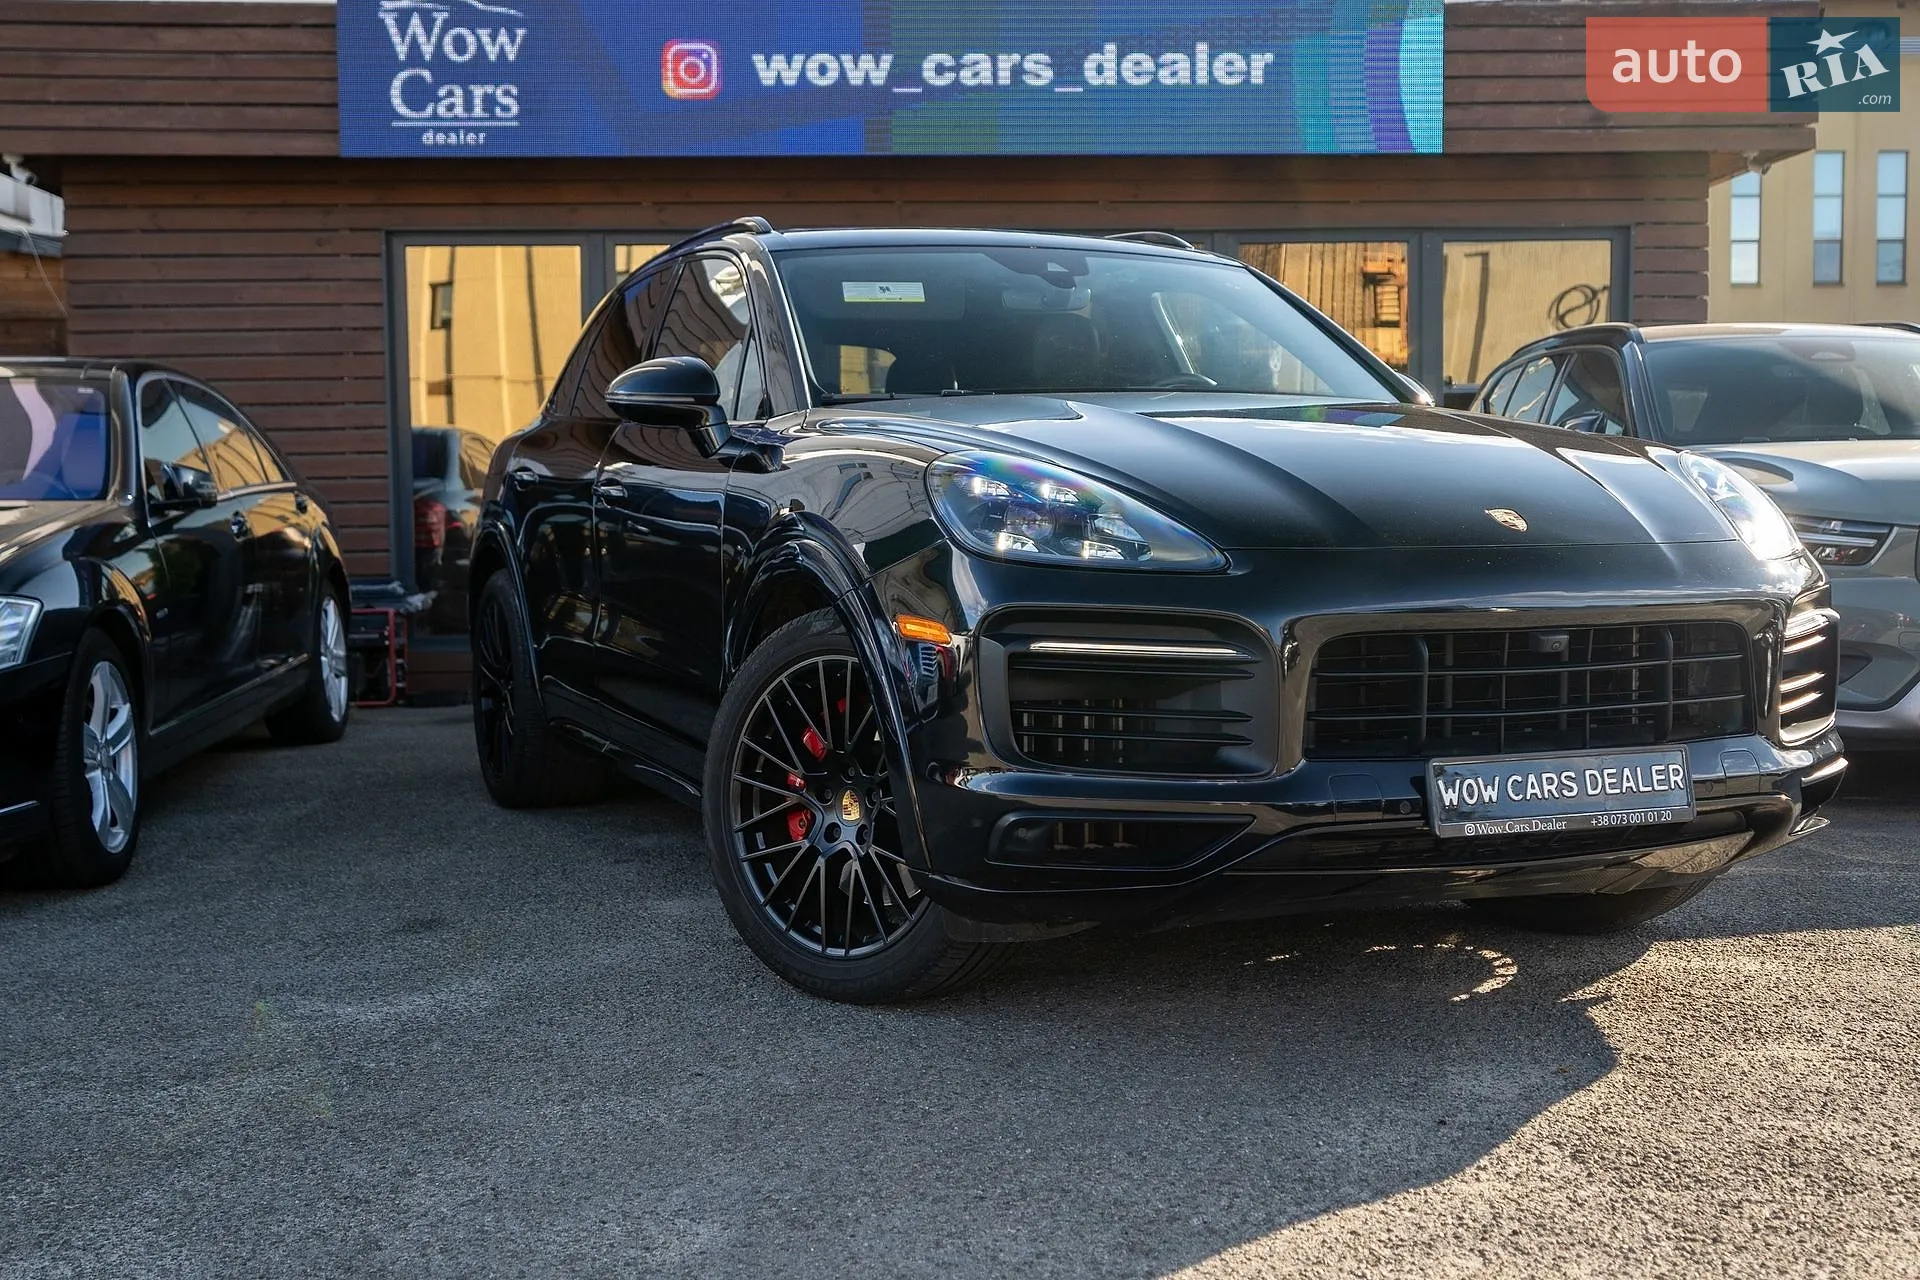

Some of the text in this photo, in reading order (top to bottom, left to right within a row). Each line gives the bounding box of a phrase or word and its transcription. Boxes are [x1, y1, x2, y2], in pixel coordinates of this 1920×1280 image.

[378, 11, 526, 62] Wow
[752, 42, 1274, 93] wow_cars_dealer
[390, 69, 520, 118] Cars
[422, 129, 486, 145] dealer
[1437, 763, 1685, 810] WOW CARS DEALER
[1591, 810, 1672, 827] +38 073 001 01 20
